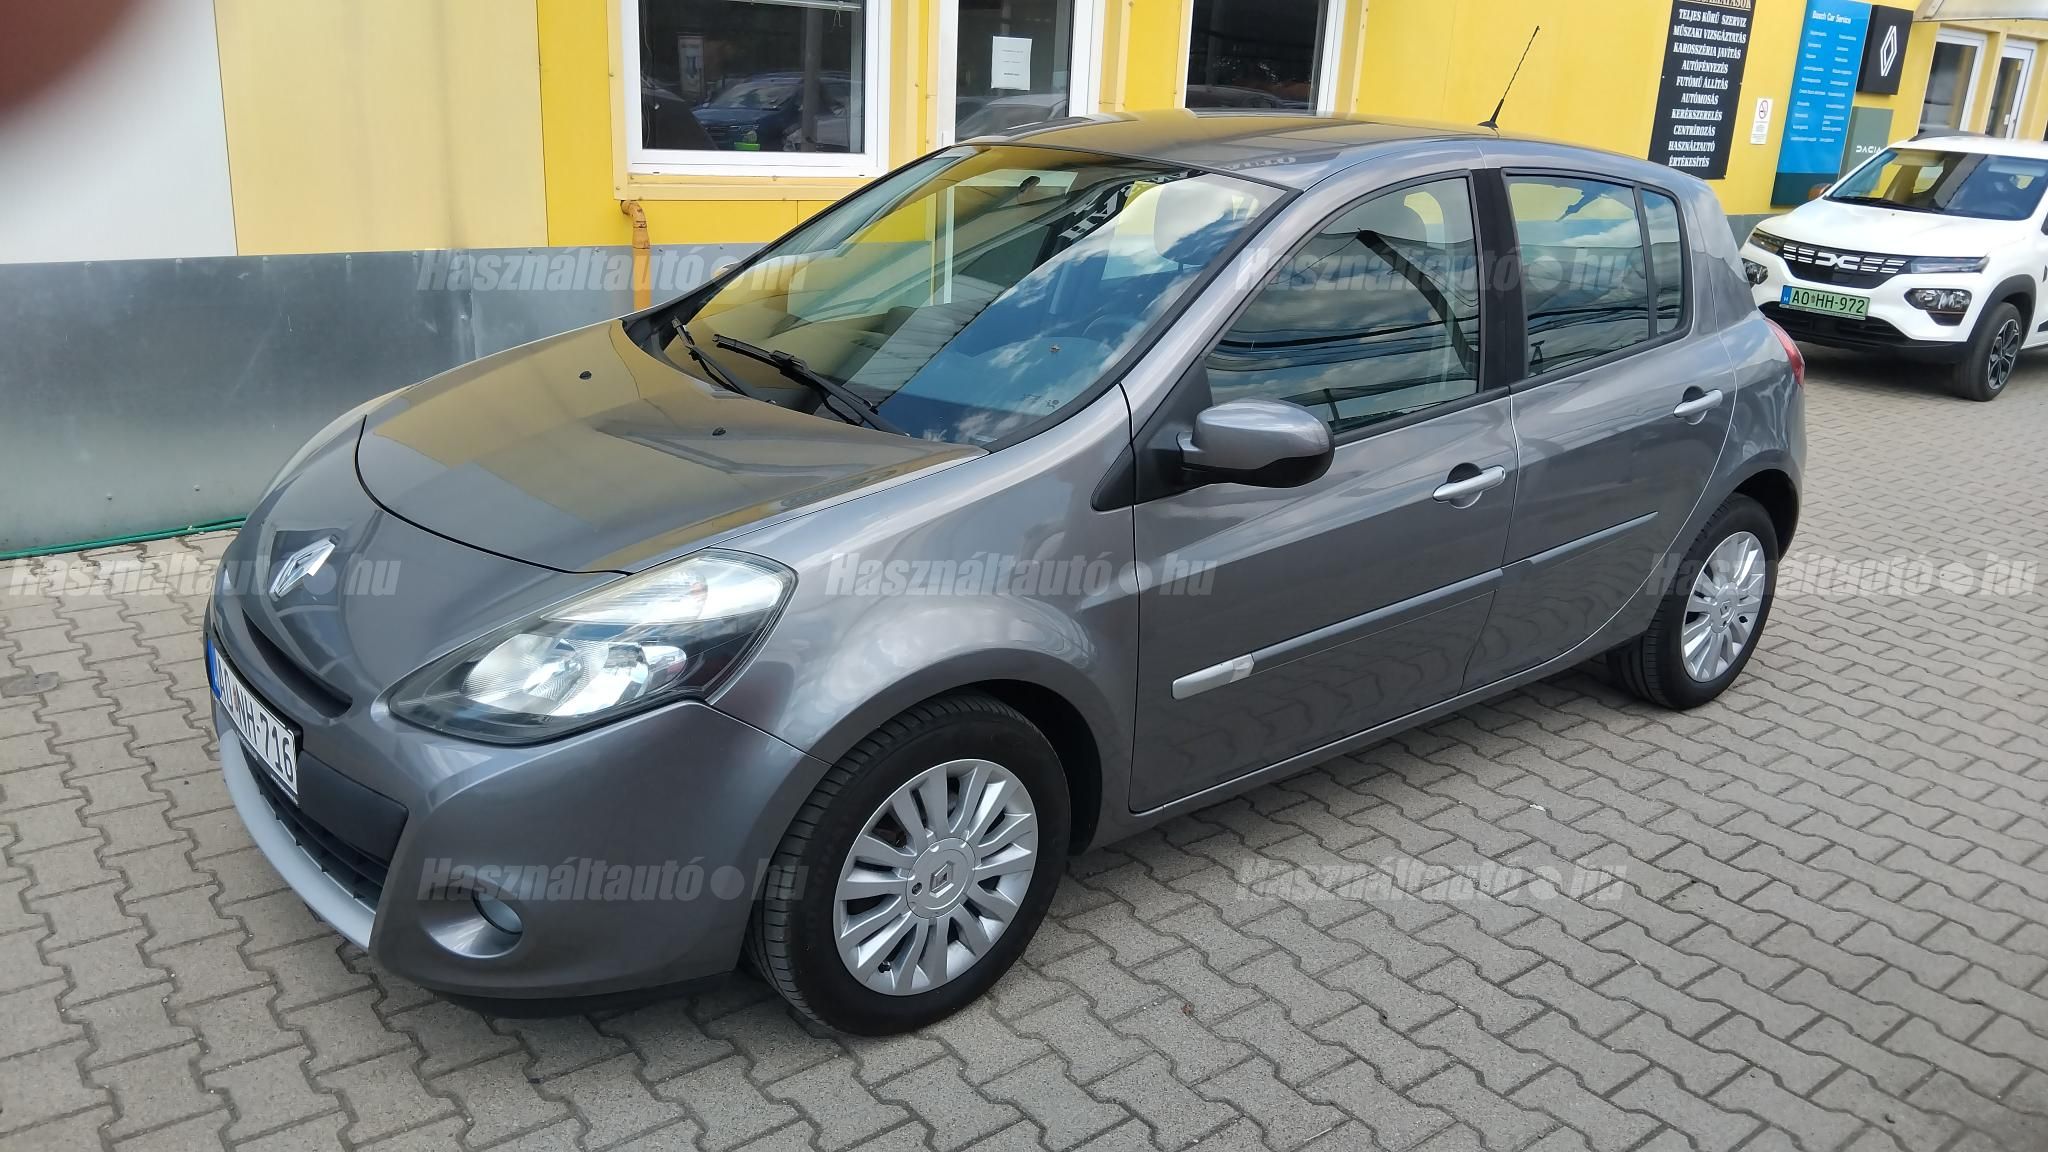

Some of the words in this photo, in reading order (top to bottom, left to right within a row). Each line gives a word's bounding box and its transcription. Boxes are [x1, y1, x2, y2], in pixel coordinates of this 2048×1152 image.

[1679, 9, 1701, 22] TELJES
[1721, 14, 1747, 27] SZERVIZ
[1673, 42, 1716, 56] KAROSSZÉRIA
[1717, 46, 1741, 59] JAVÍTÁS
[1671, 108, 1723, 121] KERÉKSZERELÉS
[1668, 140, 1715, 152] HASZNÁLTAUTÓ
[1816, 293, 1865, 314] HH-972
